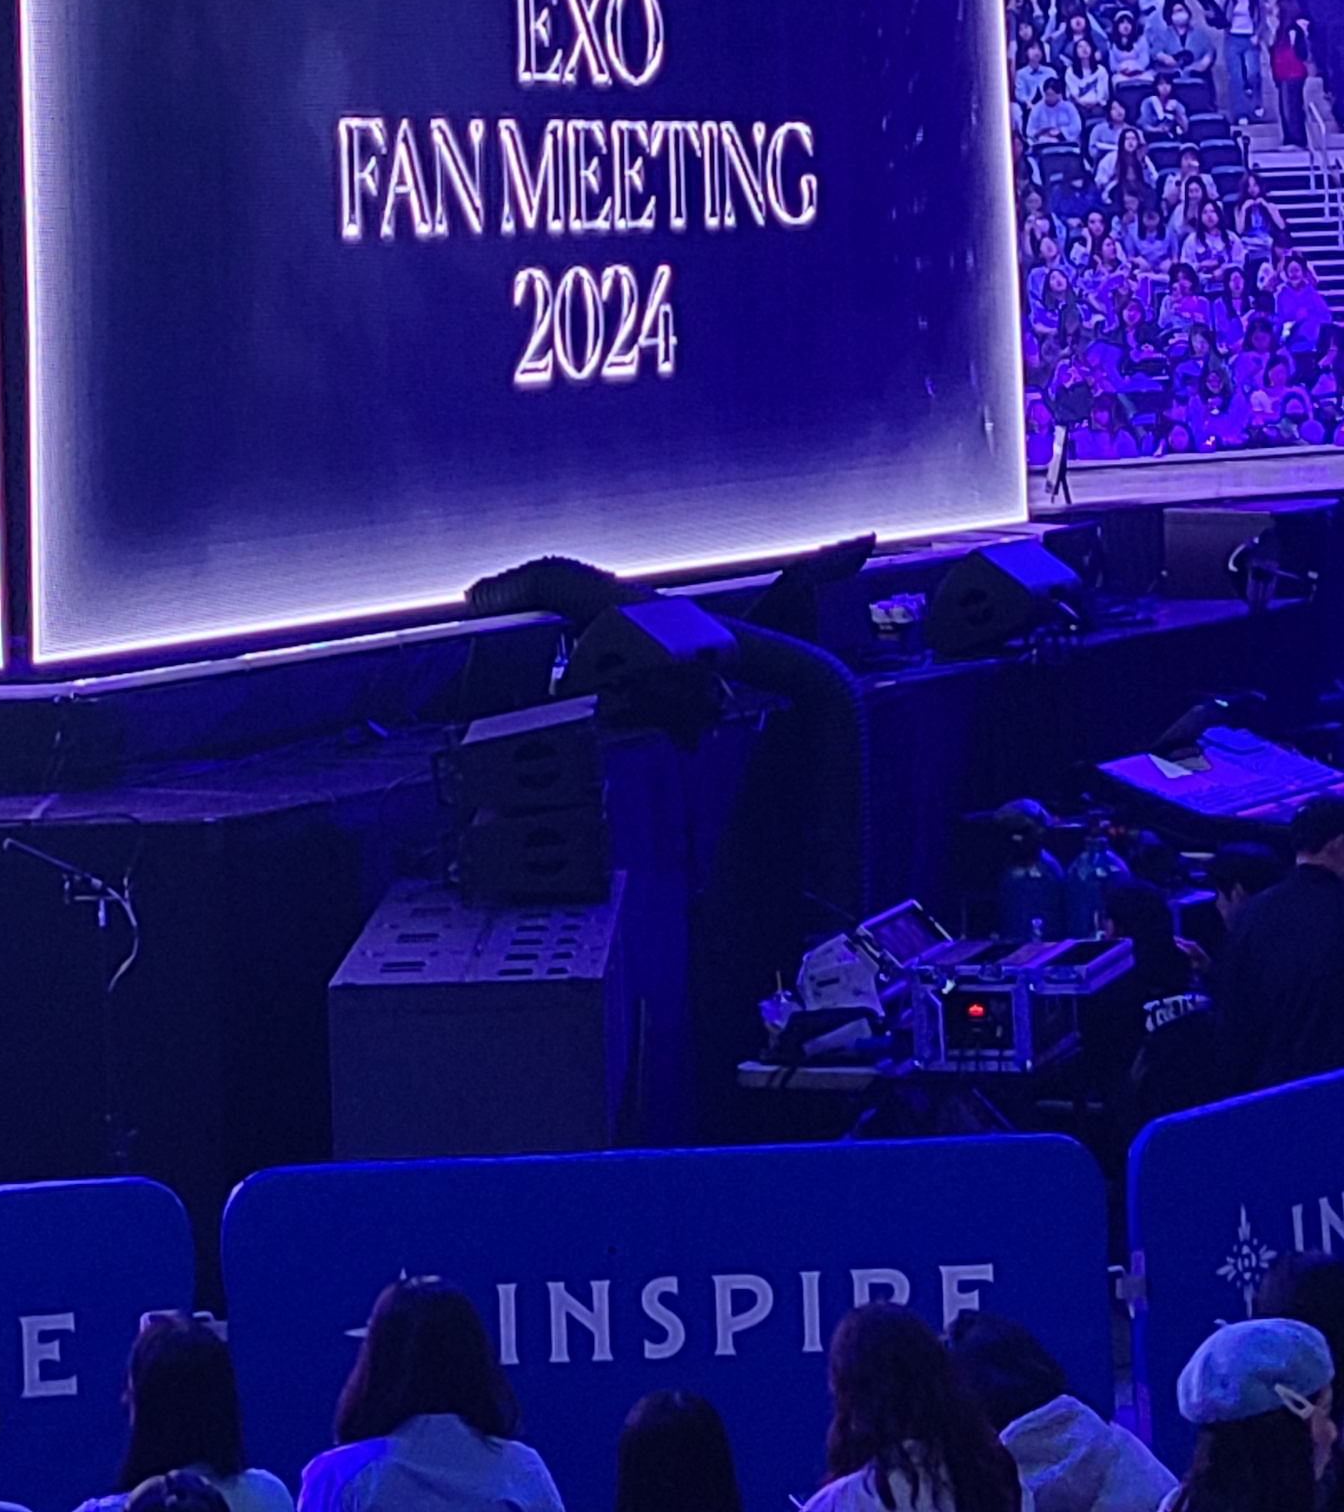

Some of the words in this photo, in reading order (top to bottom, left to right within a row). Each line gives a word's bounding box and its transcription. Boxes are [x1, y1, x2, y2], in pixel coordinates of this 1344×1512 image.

[337, 117, 485, 240] FAN
[498, 117, 818, 235] MEETING
[513, 264, 678, 387] 2024
